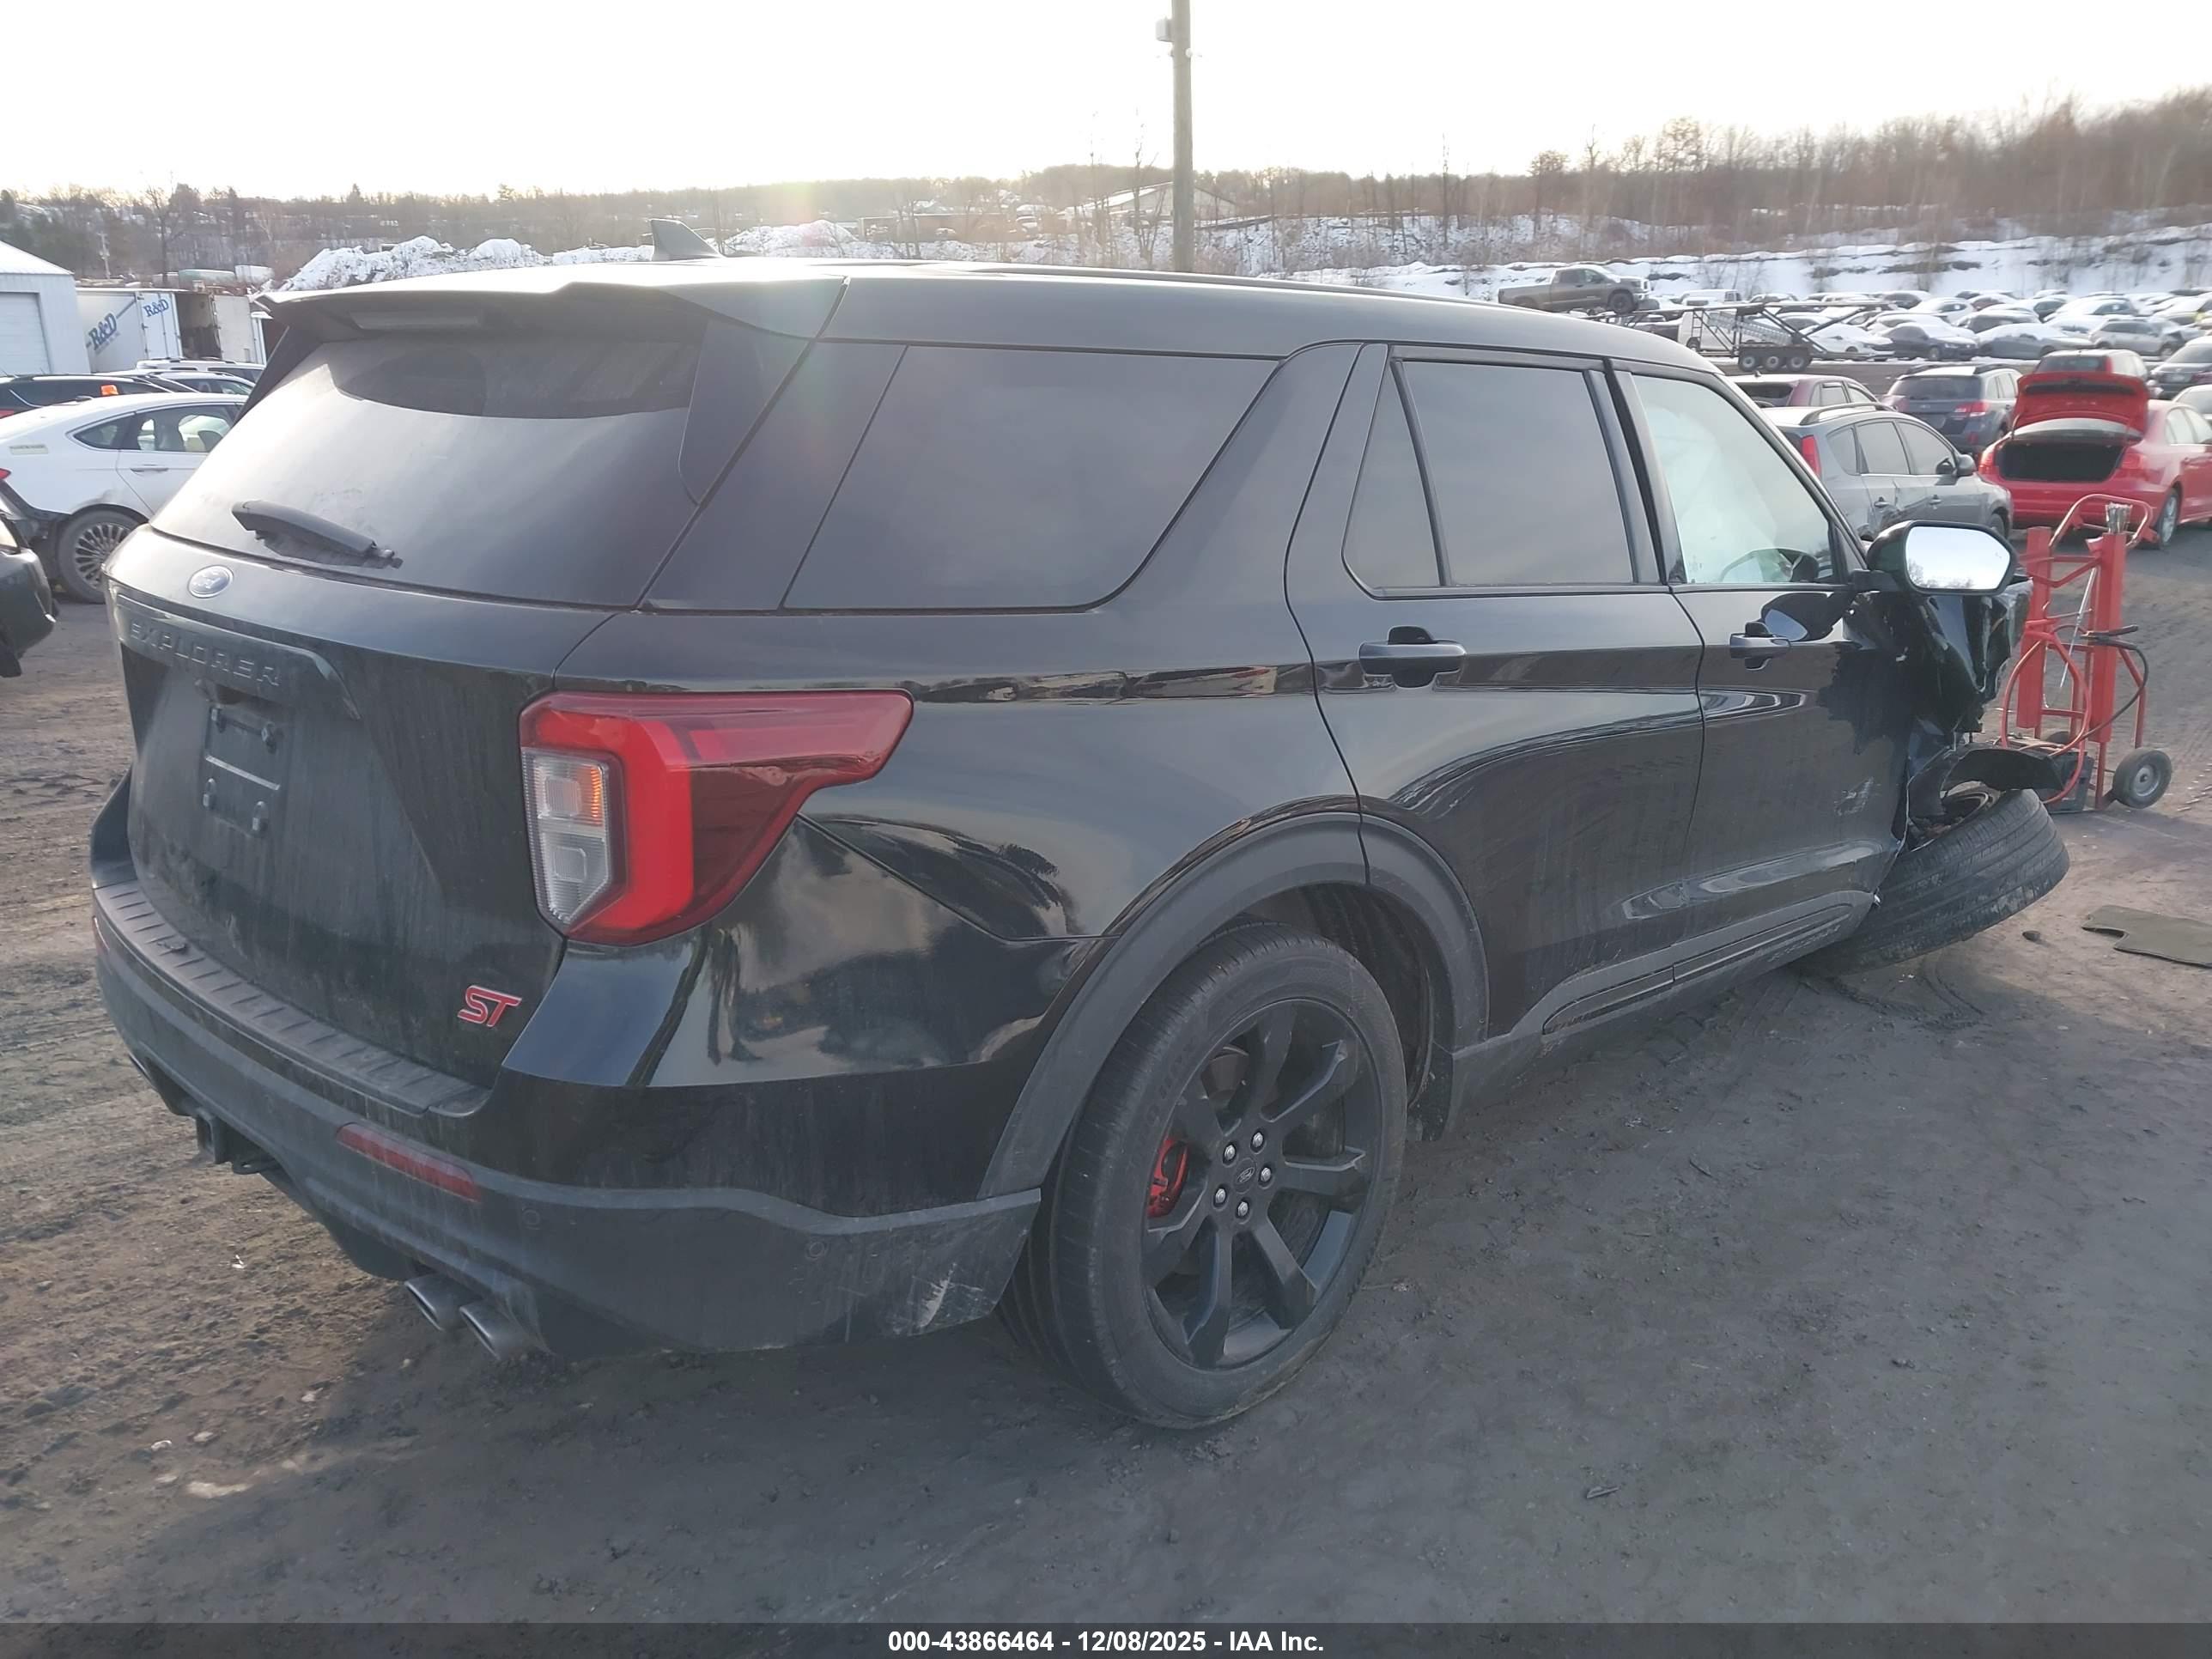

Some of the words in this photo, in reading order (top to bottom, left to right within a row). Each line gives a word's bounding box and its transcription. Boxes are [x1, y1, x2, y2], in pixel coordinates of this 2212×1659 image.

[143, 299, 169, 317] R&D
[88, 313, 117, 350] R&D
[457, 985, 522, 1027] ST
